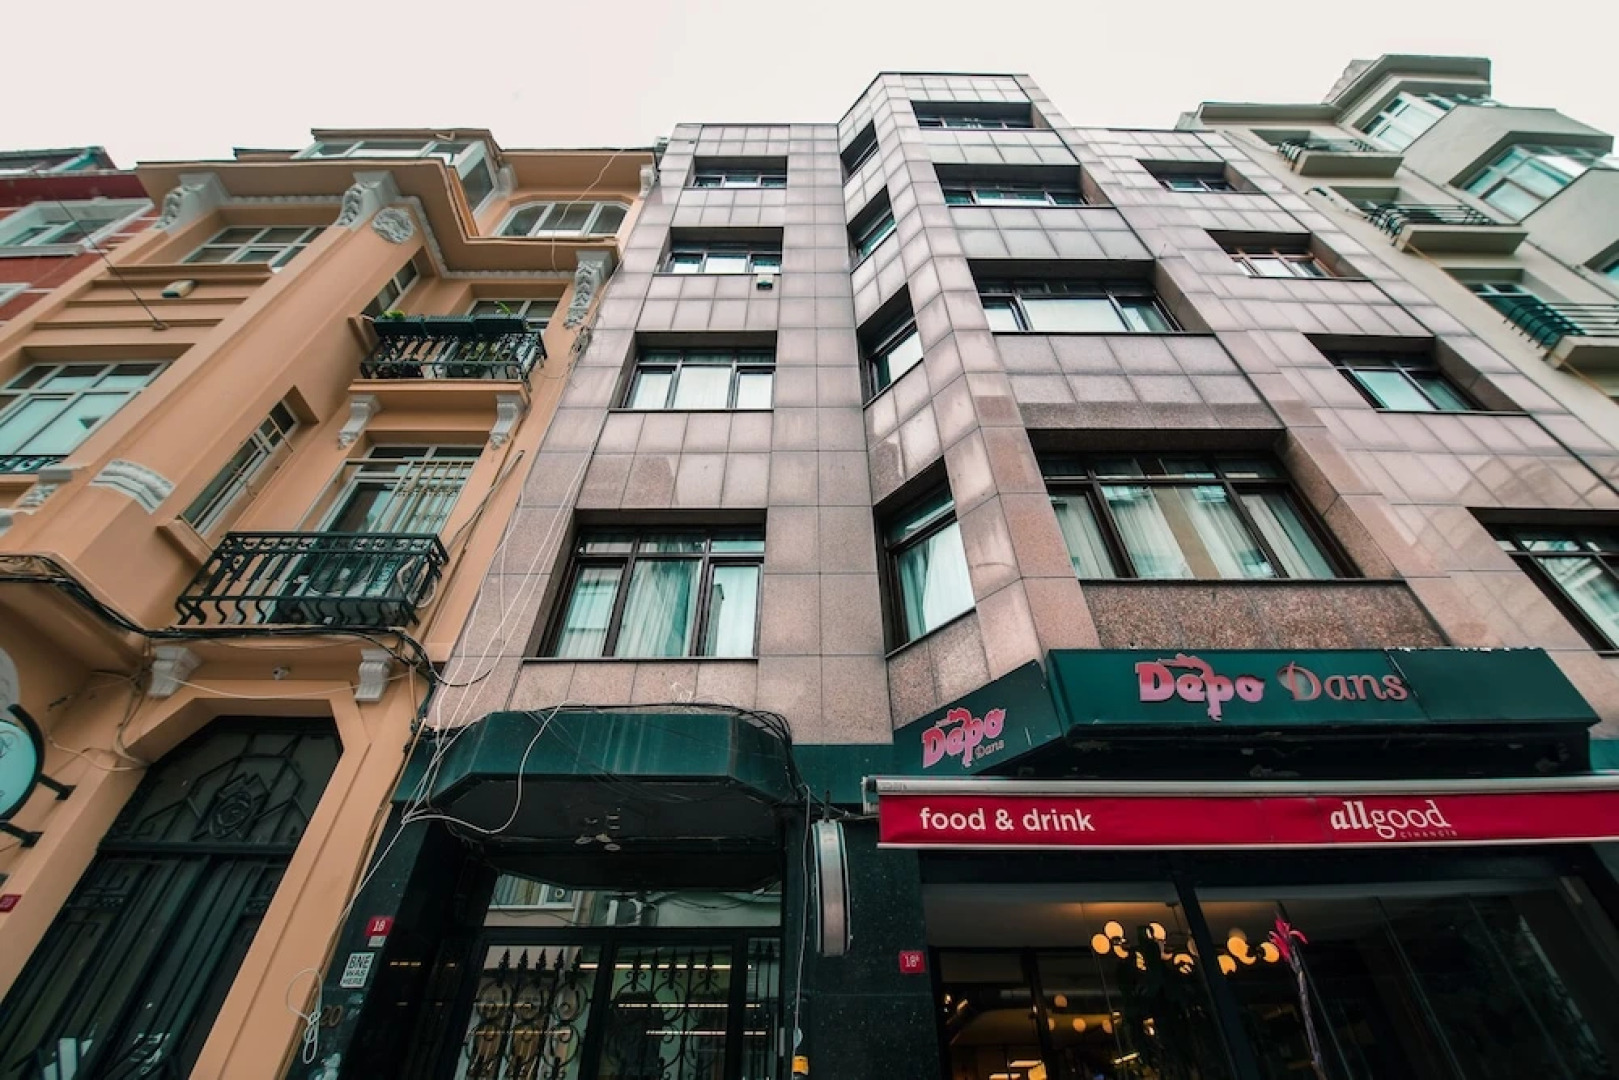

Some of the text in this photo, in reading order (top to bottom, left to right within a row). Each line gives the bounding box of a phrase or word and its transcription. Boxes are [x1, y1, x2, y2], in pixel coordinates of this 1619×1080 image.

[1135, 653, 1408, 721] Depo Dans
[922, 707, 1007, 768] Depo
[975, 739, 1004, 759] Dans
[919, 807, 1096, 832] food & drink
[1330, 799, 1452, 839] allgood
[373, 920, 386, 931] 18
[345, 969, 366, 977] WAS
[348, 955, 372, 969] BNE
